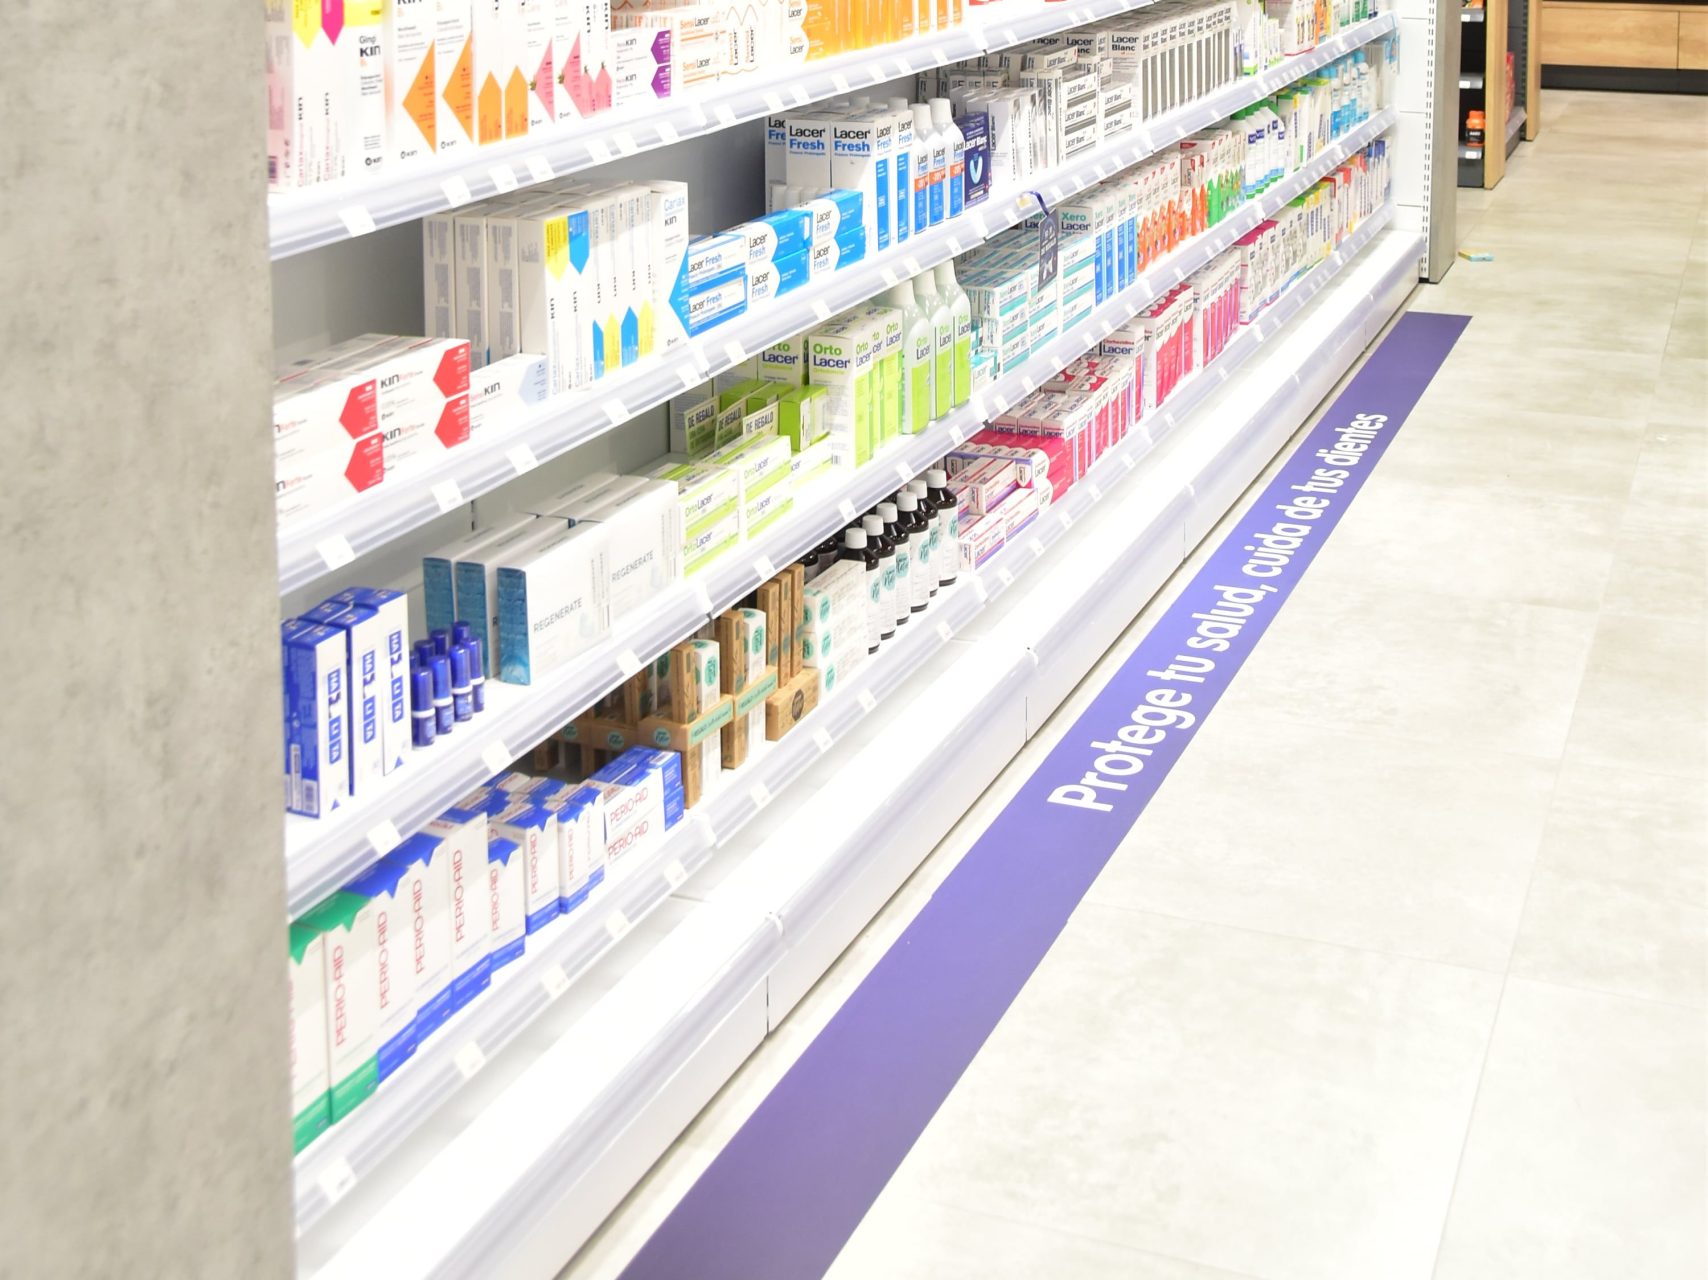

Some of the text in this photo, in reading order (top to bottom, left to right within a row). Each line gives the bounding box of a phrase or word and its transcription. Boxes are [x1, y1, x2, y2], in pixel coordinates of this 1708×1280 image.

[1112, 35, 1139, 43] Lacer
[768, 117, 786, 129] Lac
[768, 130, 786, 141] Fre
[789, 125, 826, 139] Lacer
[833, 127, 871, 140] Lacer
[789, 138, 825, 151] Fresh
[833, 140, 871, 153] Fresh
[816, 209, 832, 224] Lacer
[1062, 213, 1087, 221] Xero
[1025, 219, 1039, 229] Lac
[1061, 222, 1091, 231] Lacer
[750, 233, 768, 248] Lacer
[814, 245, 830, 260] Lacer
[752, 271, 770, 287] Lacer
[812, 343, 843, 356] Orto
[1103, 345, 1133, 355] Lacer
[762, 351, 799, 365] Lacer
[812, 356, 850, 369] Lacer
[611, 550, 654, 584] REGENERATE
[533, 597, 583, 633] REGENERATE
[1047, 413, 1388, 812] Protege tu salud, cuida de tus dientes
